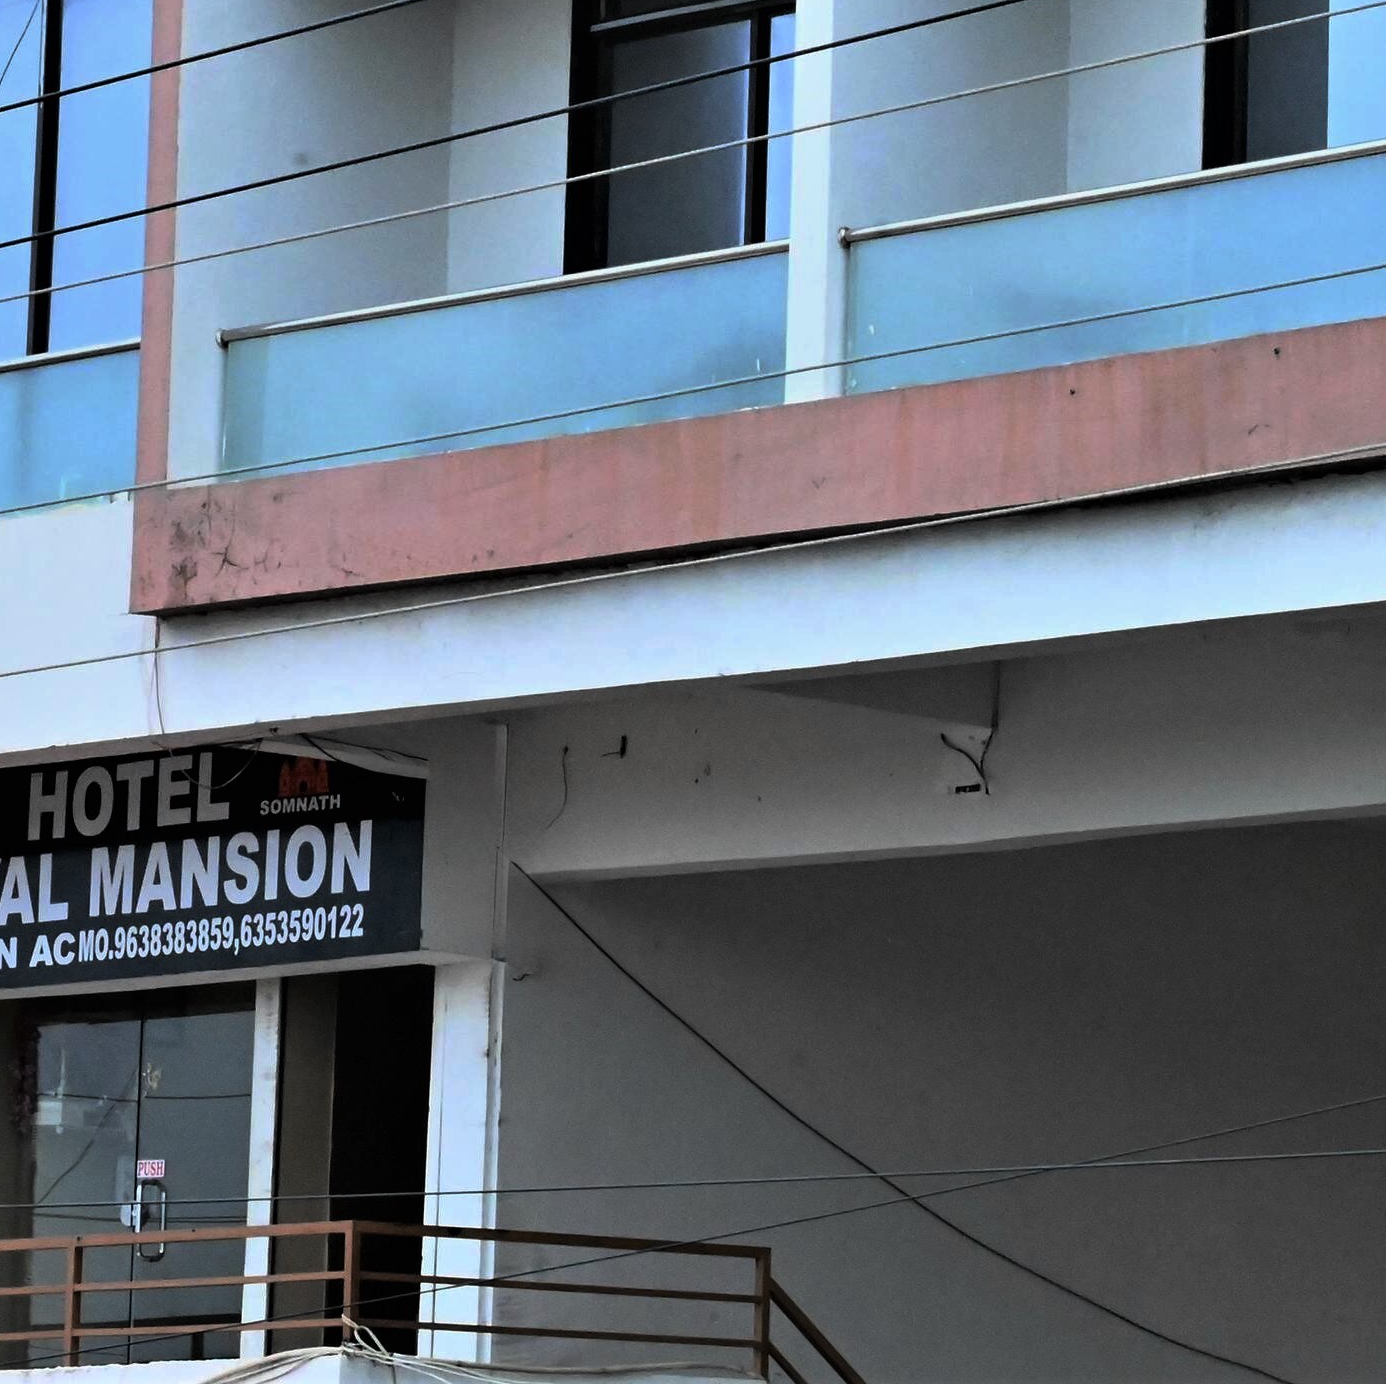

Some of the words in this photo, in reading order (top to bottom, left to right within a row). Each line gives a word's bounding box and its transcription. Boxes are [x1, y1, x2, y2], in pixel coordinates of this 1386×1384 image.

[28, 753, 230, 840] HOTEL
[260, 795, 341, 814] SOMNATH
[89, 820, 372, 917] MANSION
[138, 1161, 164, 1176] PUSH
